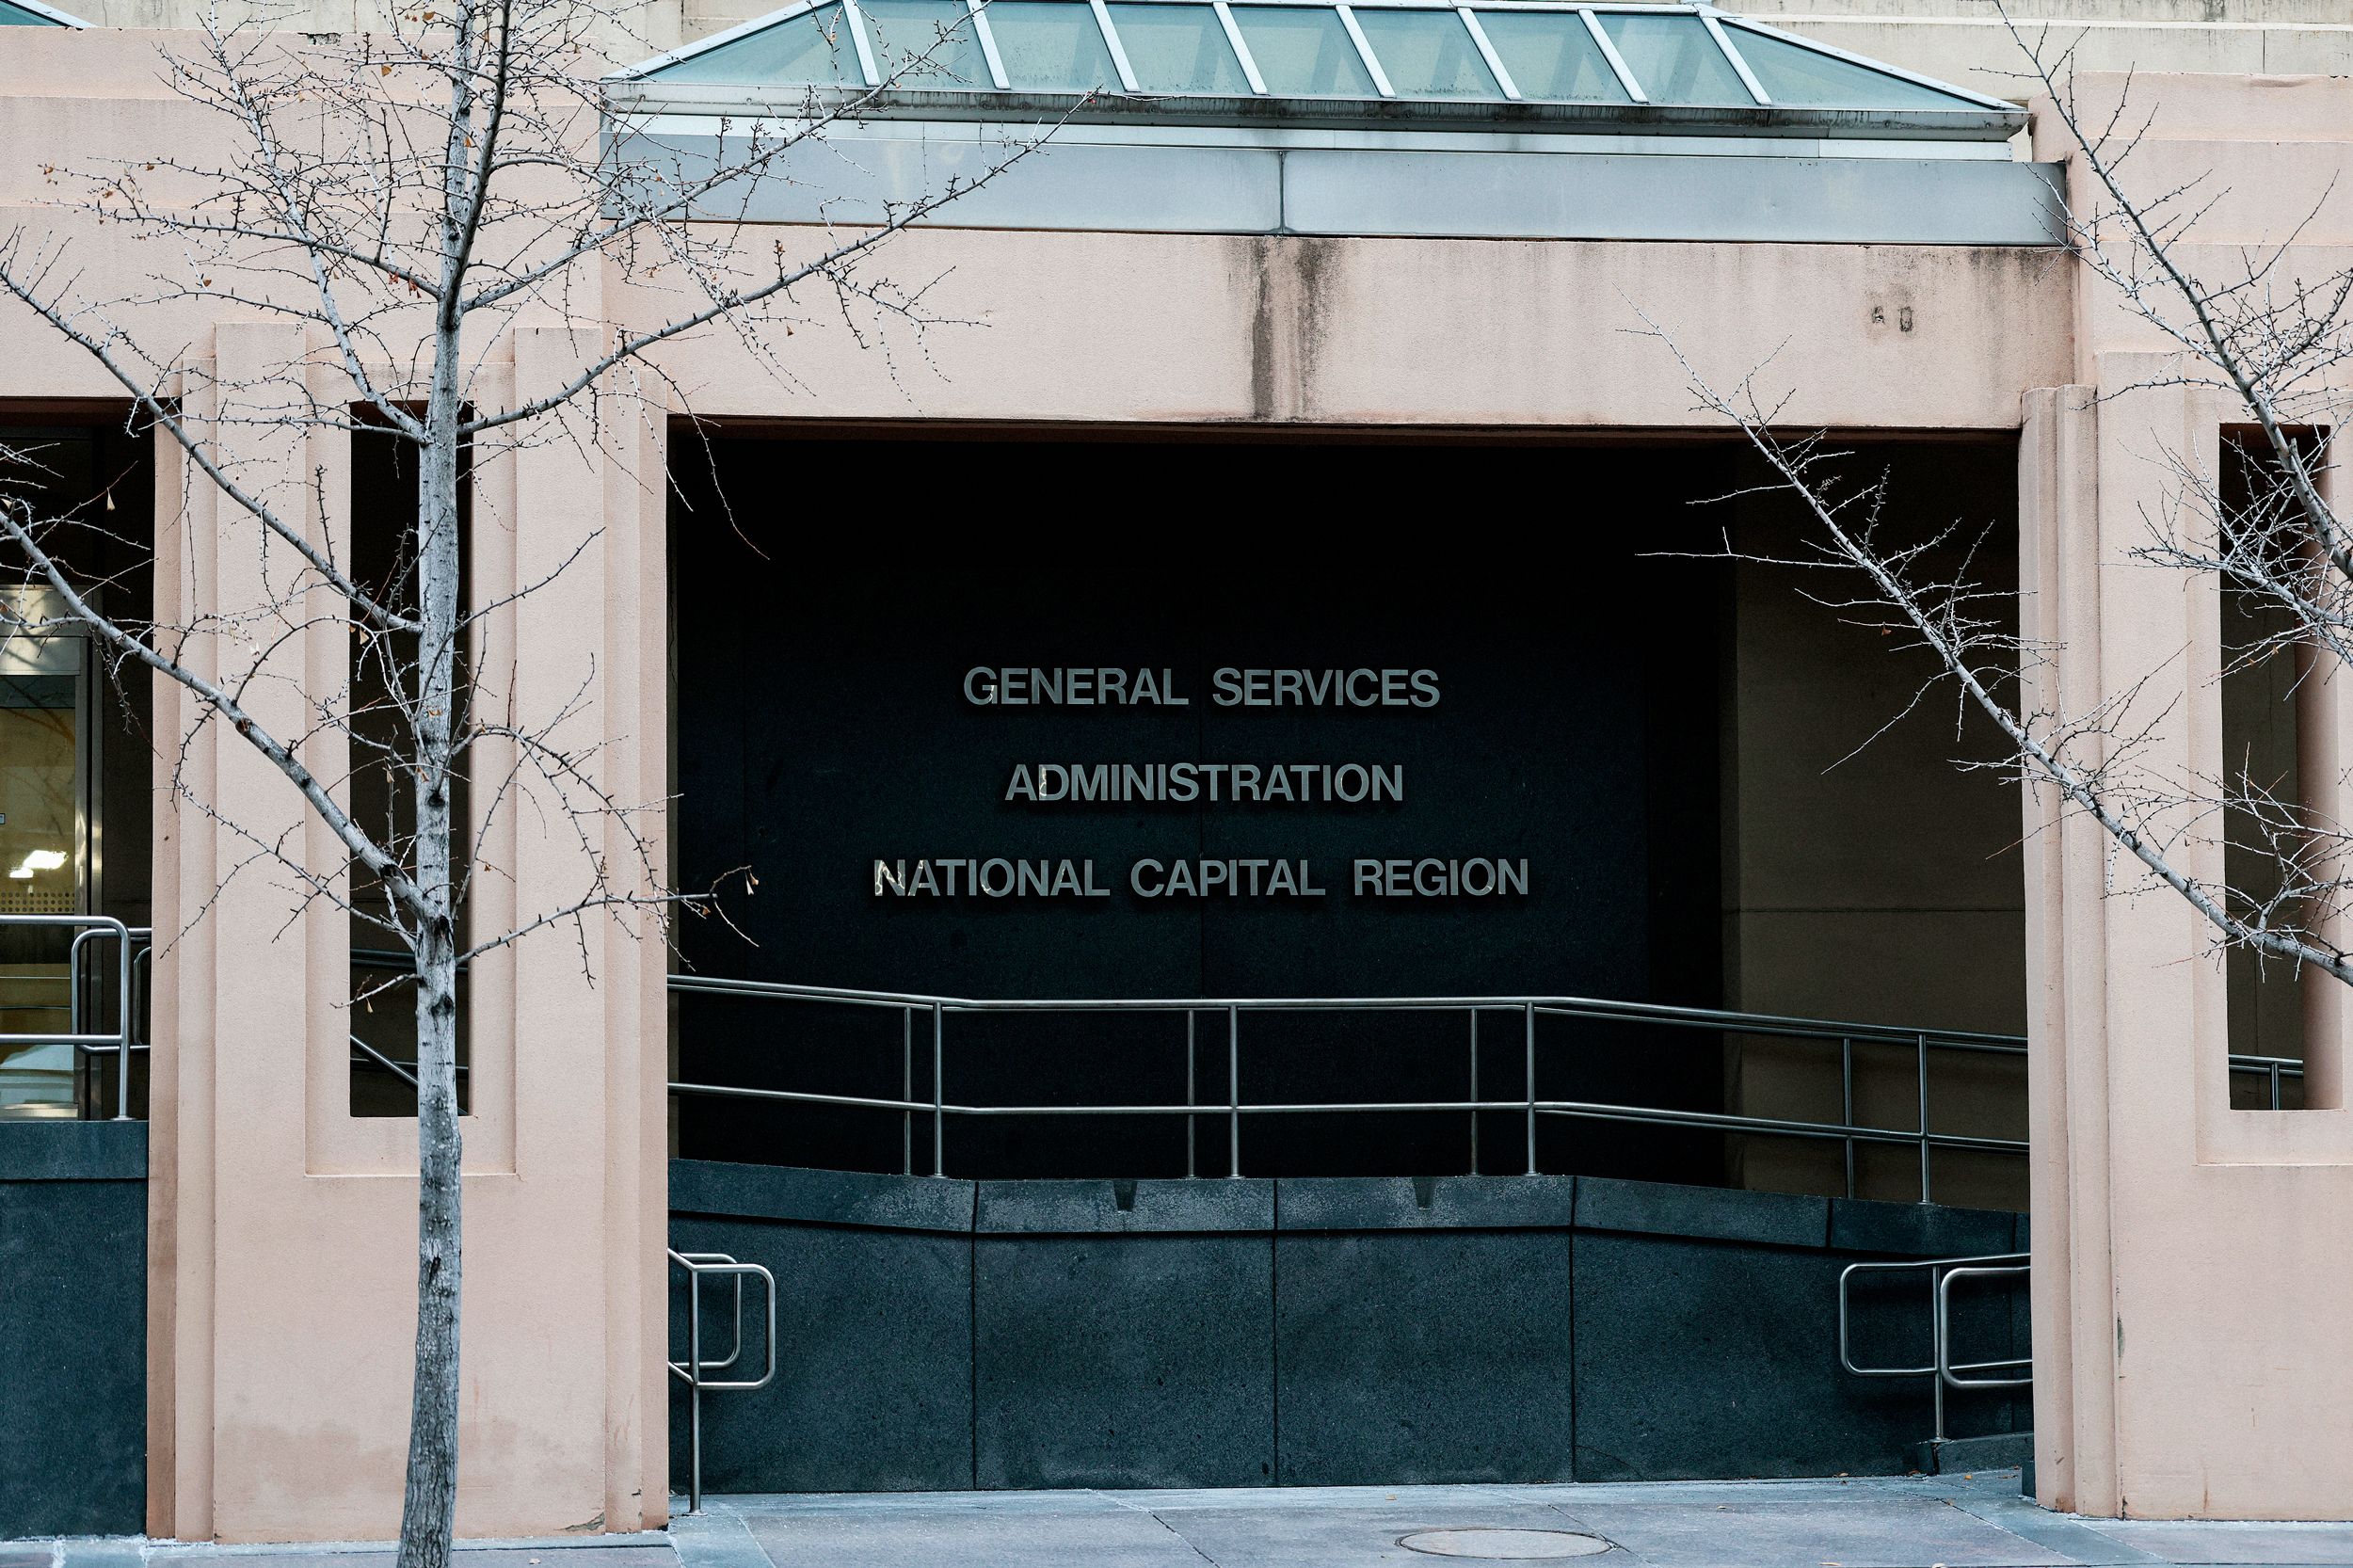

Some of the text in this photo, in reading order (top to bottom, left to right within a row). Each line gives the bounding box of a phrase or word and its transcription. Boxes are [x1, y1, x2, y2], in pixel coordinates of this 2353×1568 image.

[963, 666, 1440, 707] GENERAL SERVICES
[1004, 762, 1403, 802] ADMINISTRATION
[873, 857, 1529, 897] NATIONAL CAPITAL REGION
